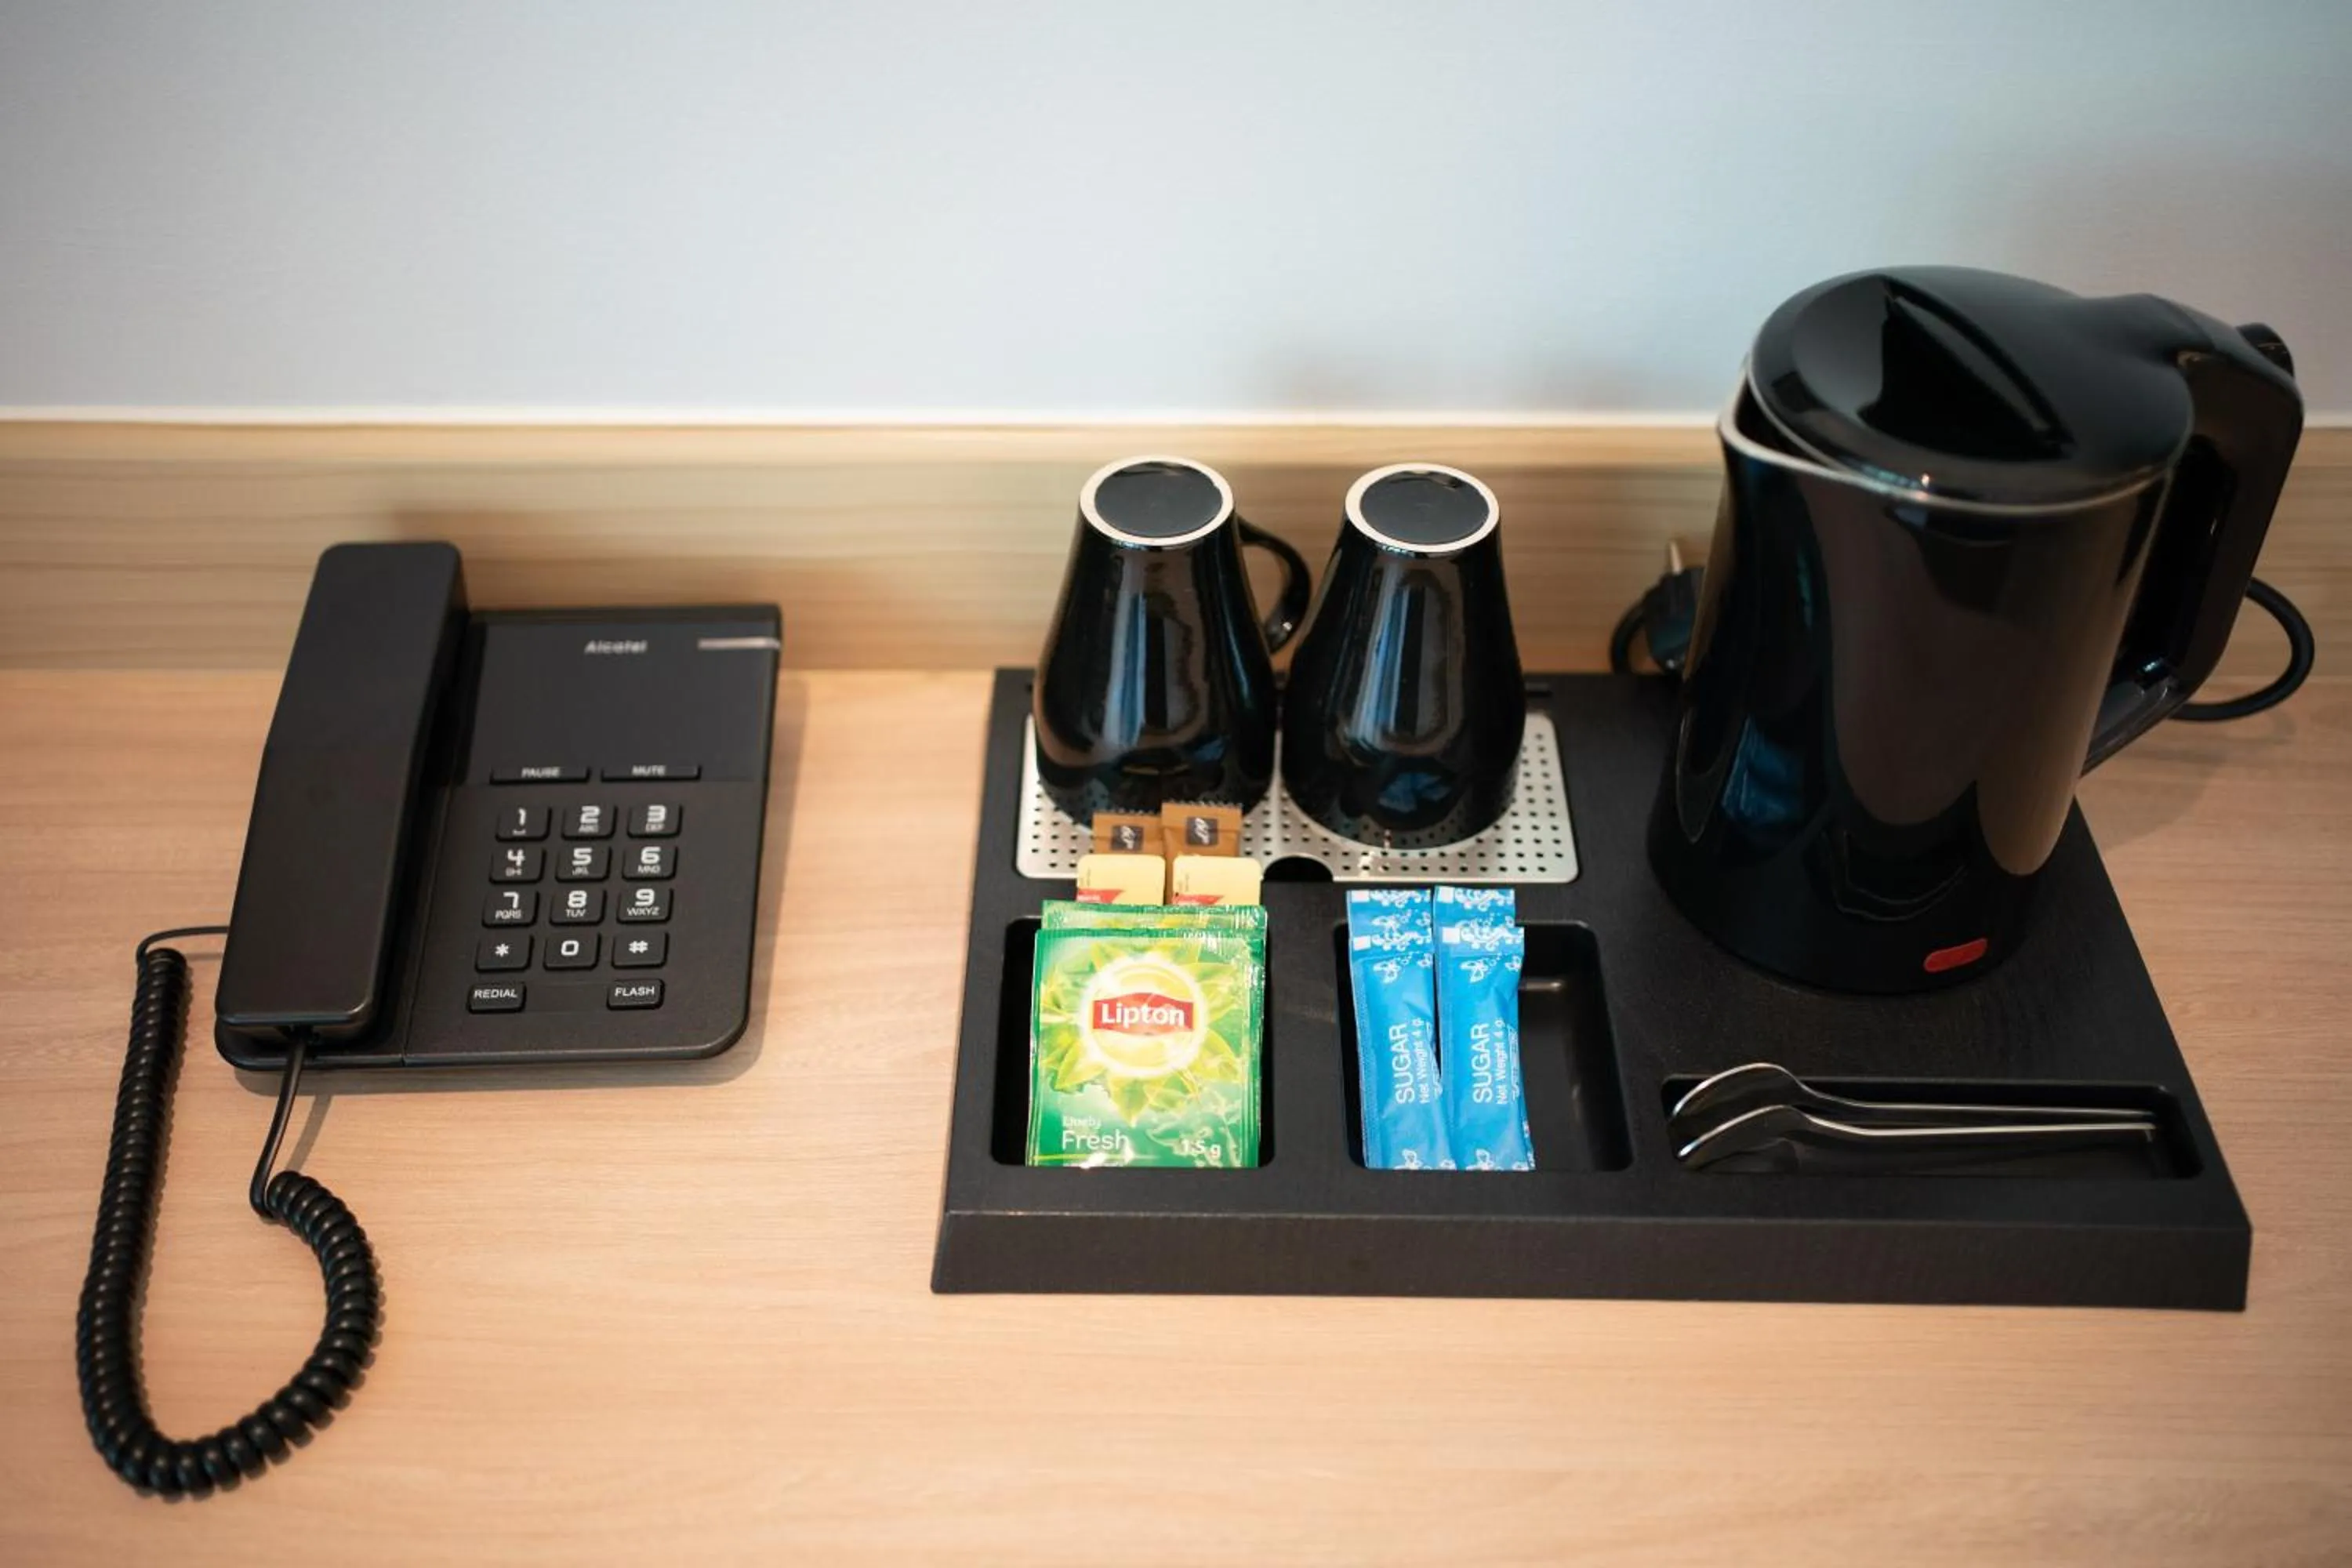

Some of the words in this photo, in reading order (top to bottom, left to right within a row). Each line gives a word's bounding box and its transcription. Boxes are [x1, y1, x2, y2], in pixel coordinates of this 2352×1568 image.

[583, 640, 648, 655] Alcatel
[521, 767, 561, 779] PAUSE
[631, 764, 666, 777] MUTE
[518, 808, 526, 826] 1
[580, 805, 600, 823] 2
[647, 805, 666, 822] 3
[507, 849, 524, 866] 4
[572, 848, 592, 866] 5
[641, 847, 661, 864] 6
[637, 865, 661, 874] MNO
[503, 891, 519, 909] 7
[568, 890, 587, 908] 8
[634, 888, 655, 906] 9
[565, 909, 586, 918] TUV
[626, 907, 660, 916] WXYZ
[474, 988, 517, 999] REDIAL
[615, 985, 655, 997] FLASH
[1101, 1003, 1185, 1029] Lipton
[1389, 1023, 1415, 1104] SUGAR
[1470, 1023, 1493, 1103] SUGAR
[1493, 1042, 1508, 1081] Weight
[1495, 1083, 1508, 1105] Net
[1062, 1128, 1129, 1151] Fresh
